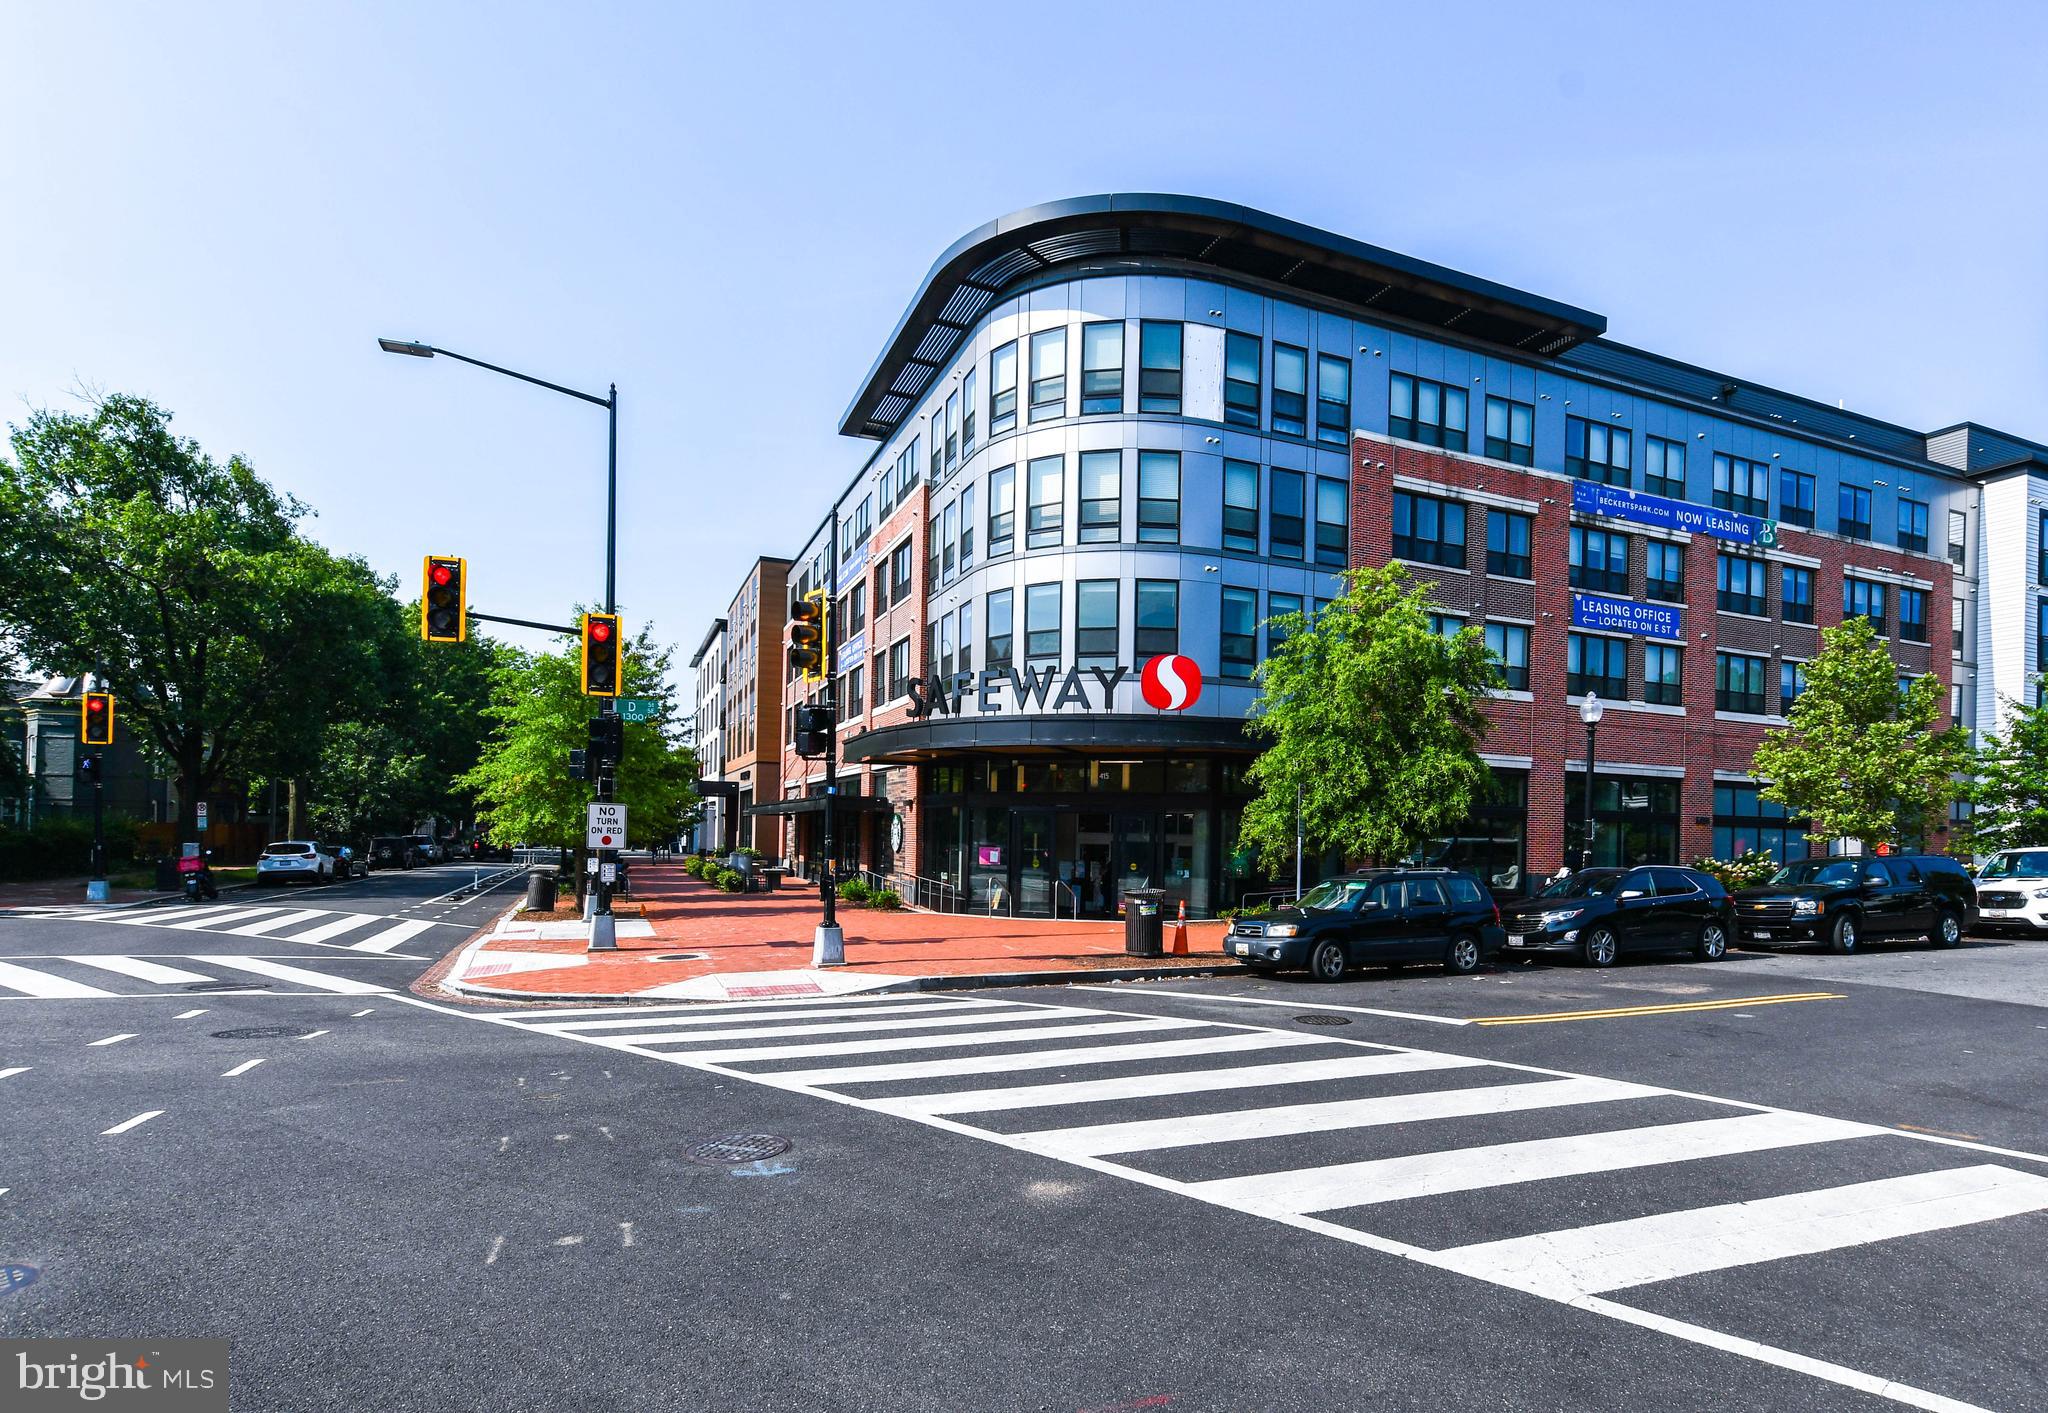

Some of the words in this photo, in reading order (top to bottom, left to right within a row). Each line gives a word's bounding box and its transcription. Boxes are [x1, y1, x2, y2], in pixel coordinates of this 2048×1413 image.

[1599, 496, 1670, 517] BECKERTSPARK.COM
[1676, 510, 1703, 526] NOW
[1706, 515, 1749, 535] LEASING
[1582, 600, 1630, 617] LEASING
[1634, 608, 1672, 624] OFFICE
[1598, 617, 1638, 630] LOCATED
[1640, 622, 1652, 632] ON
[1654, 624, 1660, 633] E
[1661, 625, 1672, 634] ST
[906, 665, 1129, 718] SAFEWAY
[628, 701, 637, 712] D
[622, 712, 644, 721] 1300
[599, 807, 616, 816] NO
[596, 817, 619, 826] TURN
[591, 826, 603, 834] ON
[606, 827, 623, 835] RED
